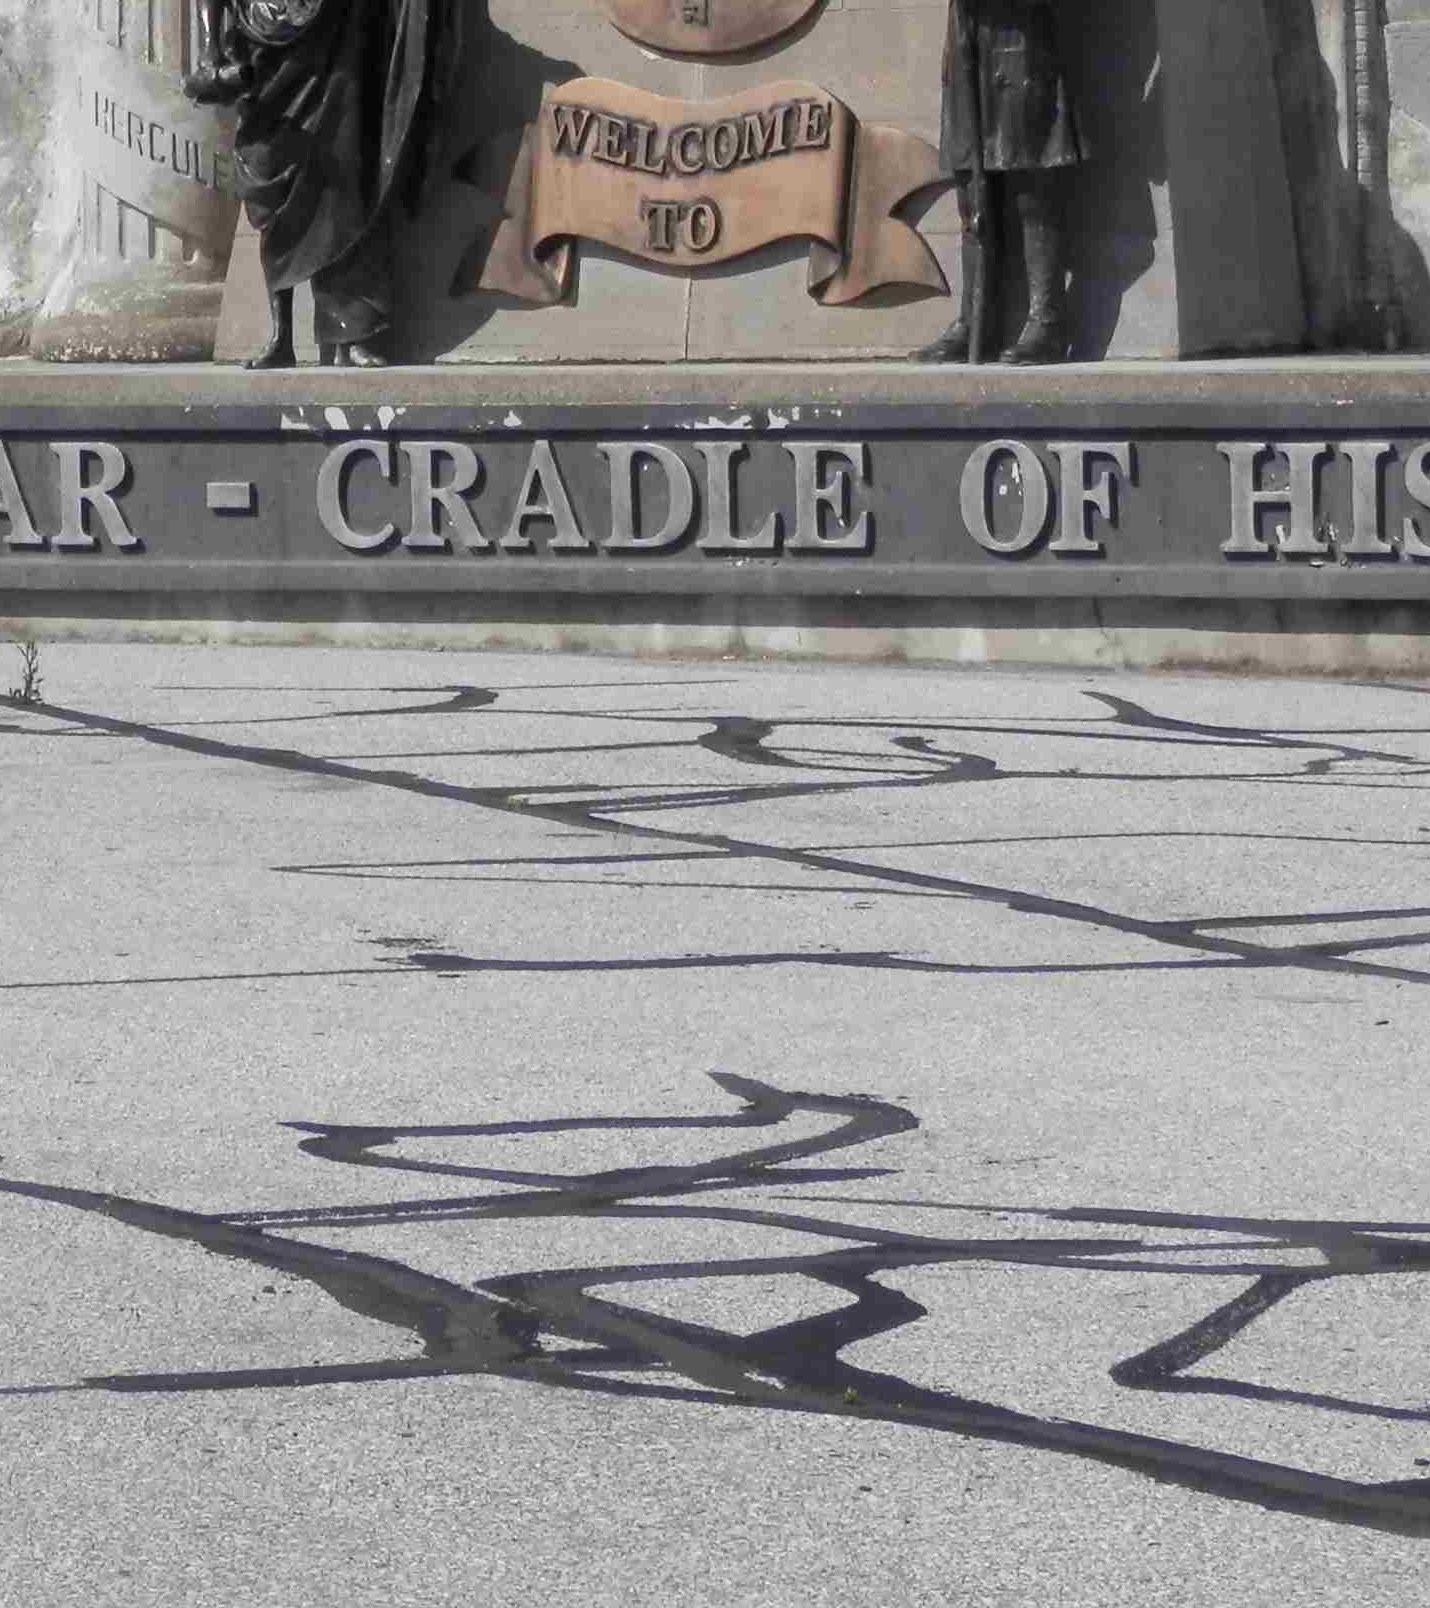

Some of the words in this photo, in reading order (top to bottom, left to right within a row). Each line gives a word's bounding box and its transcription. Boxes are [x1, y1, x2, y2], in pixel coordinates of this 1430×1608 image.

[545, 102, 831, 176] WELCOME
[641, 198, 721, 253] TO
[316, 438, 875, 551] CRADLE
[959, 438, 1137, 553] OF
